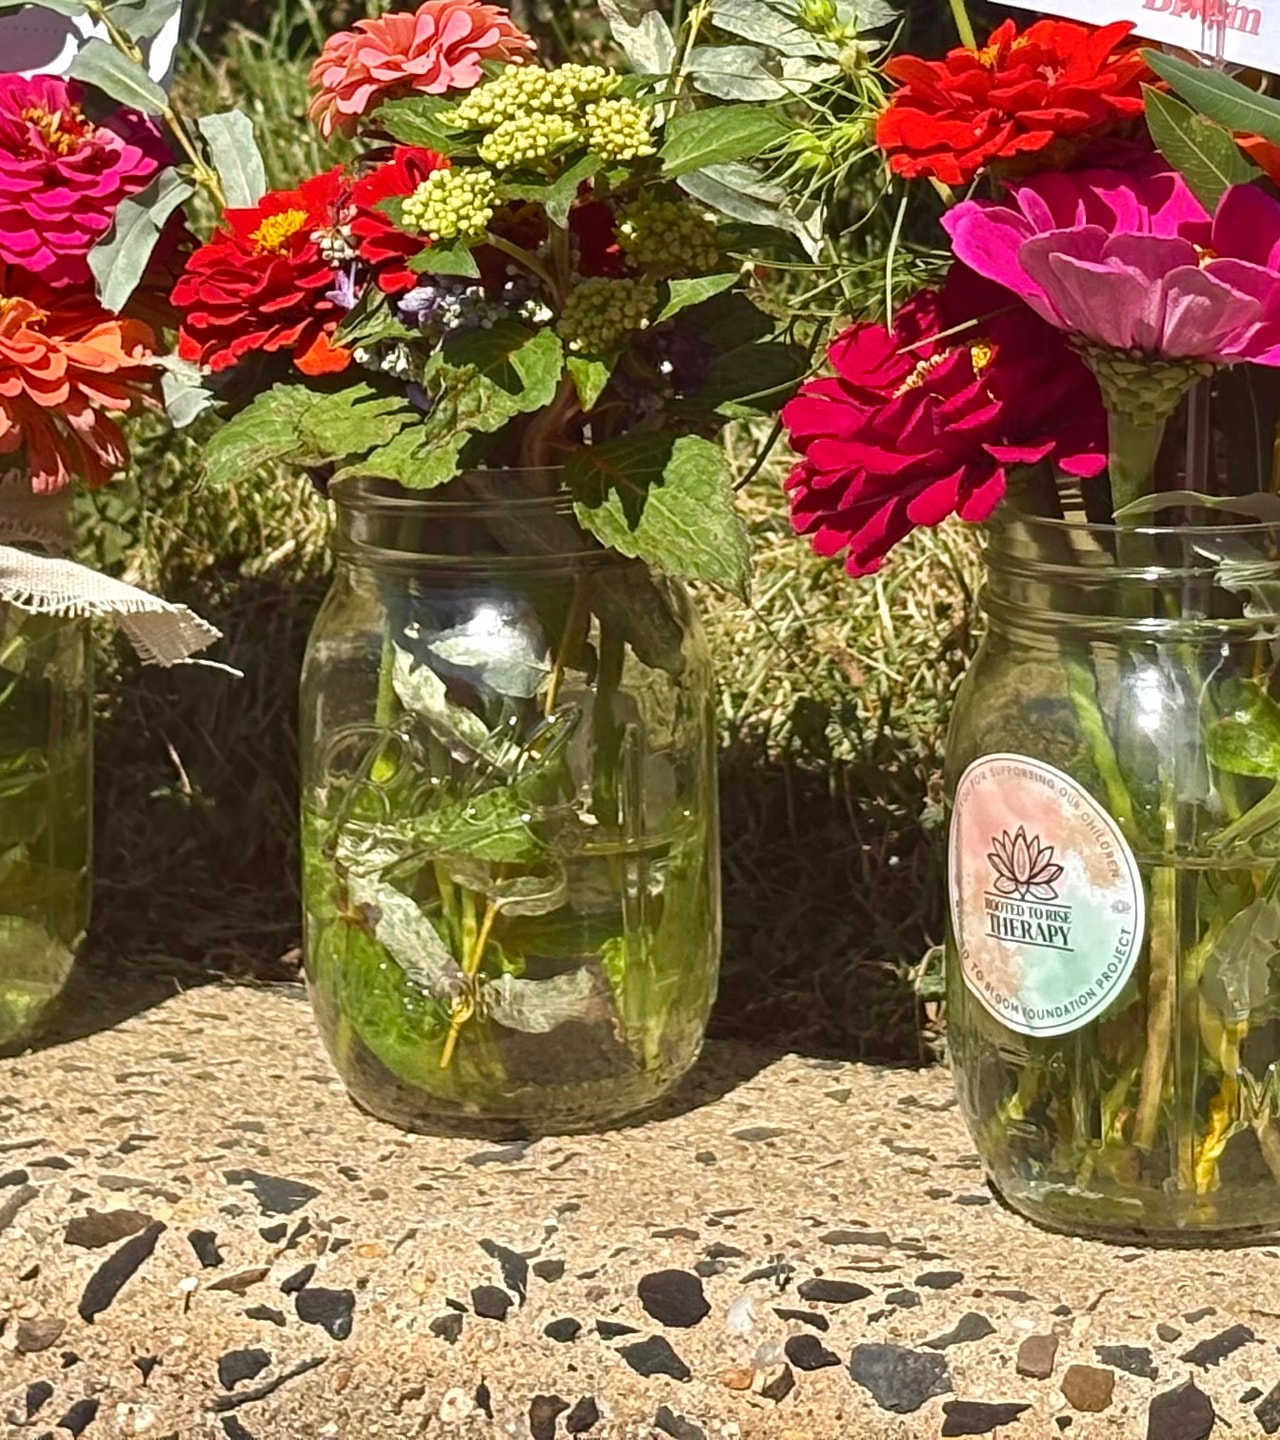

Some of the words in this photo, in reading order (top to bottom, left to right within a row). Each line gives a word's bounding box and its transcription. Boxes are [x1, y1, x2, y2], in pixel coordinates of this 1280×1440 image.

[1058, 786, 1081, 810] OUR
[1080, 811, 1120, 879] CHILDREN
[984, 897, 1026, 918] ROOTED
[1027, 905, 1044, 921] TO
[1045, 908, 1073, 925] RISE
[985, 912, 1072, 948] THERAPY
[969, 962, 985, 979] TO
[983, 981, 1021, 1017] BLOOM
[1021, 988, 1099, 1022] FOUNDATION
[1096, 927, 1133, 992] PROJECT
